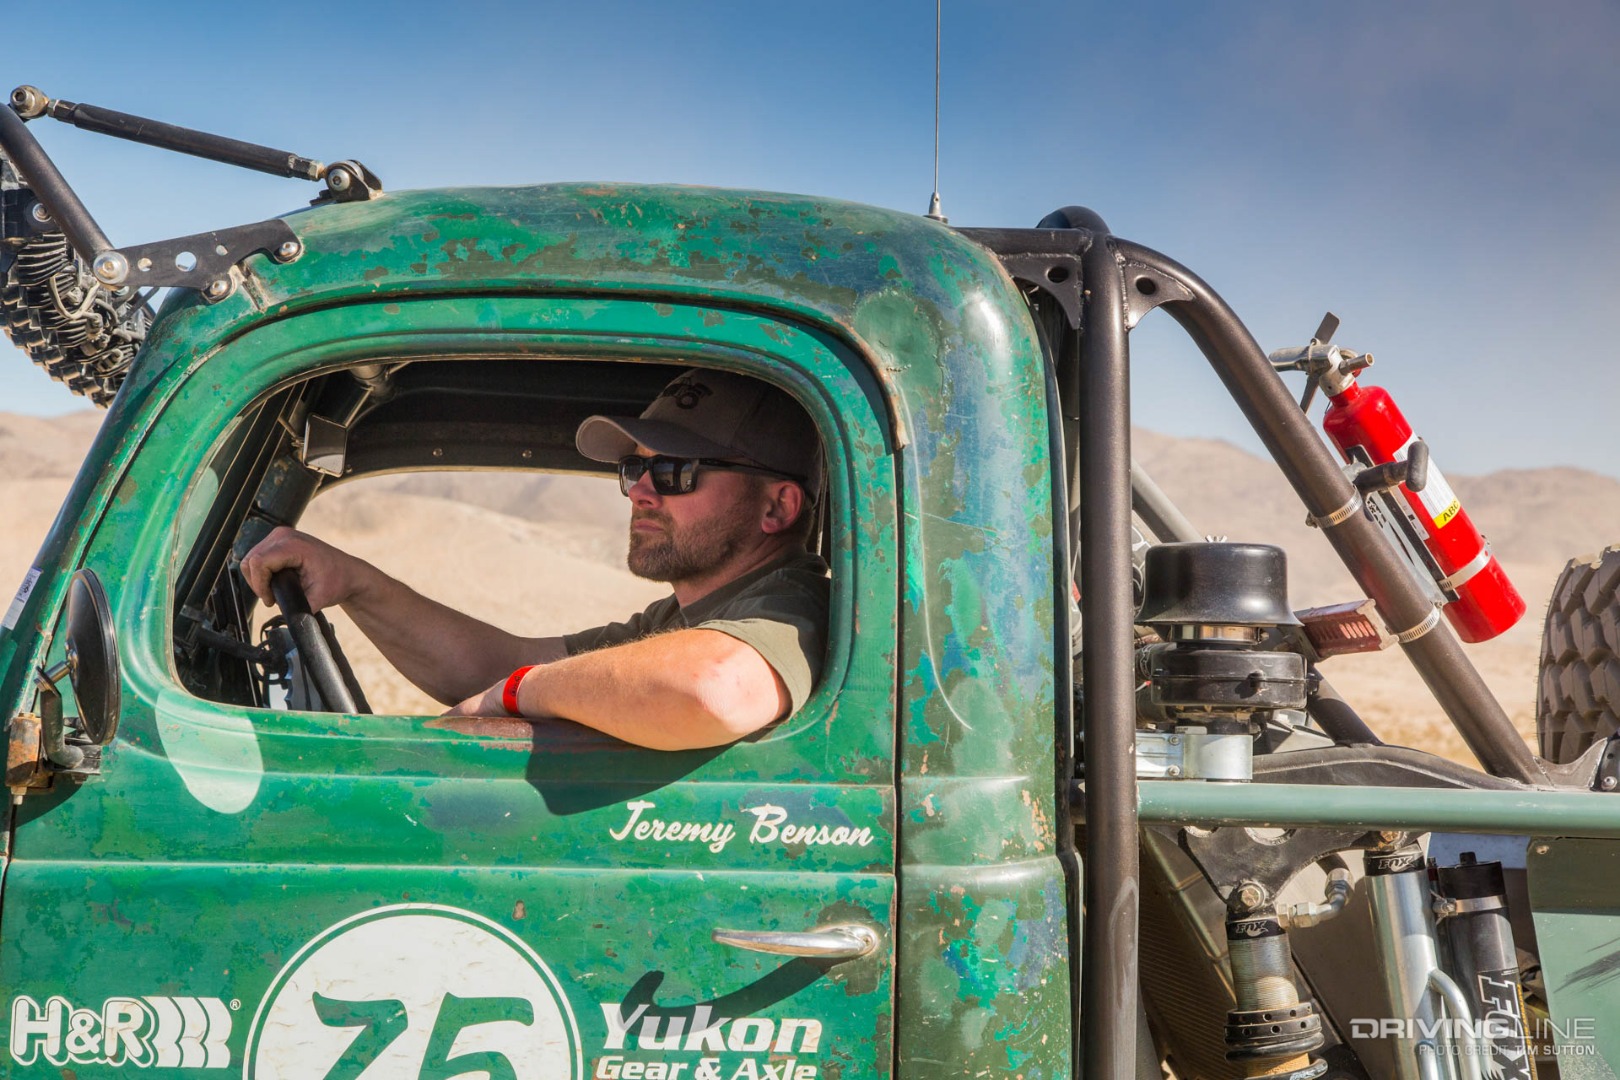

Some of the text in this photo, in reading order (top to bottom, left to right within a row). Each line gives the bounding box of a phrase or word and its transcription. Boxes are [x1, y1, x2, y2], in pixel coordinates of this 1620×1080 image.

[609, 799, 874, 854] Jeremy Benson
[1378, 856, 1416, 872] FOX
[1236, 921, 1269, 937] FOX
[312, 991, 535, 1080] 75
[600, 1002, 822, 1053] Yukon
[596, 1056, 818, 1080] Gear & Axle
